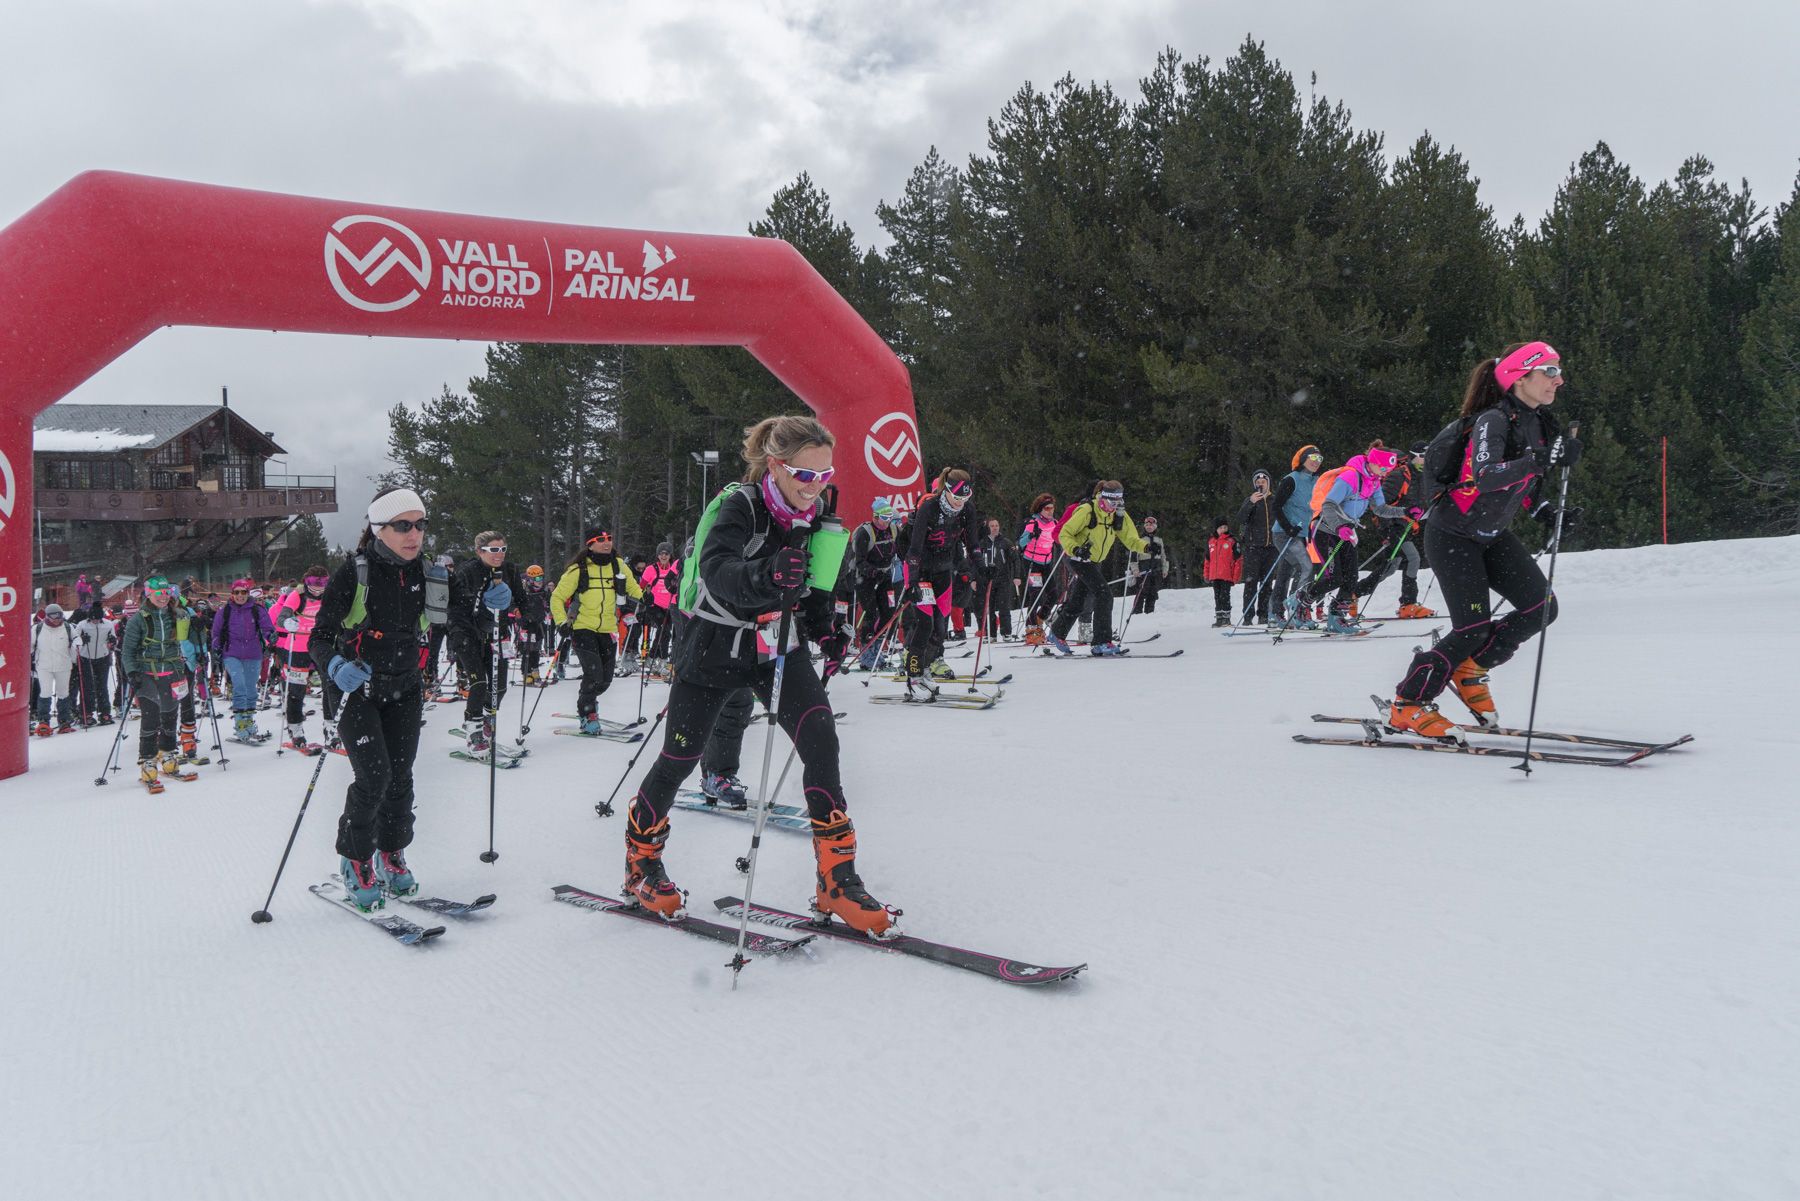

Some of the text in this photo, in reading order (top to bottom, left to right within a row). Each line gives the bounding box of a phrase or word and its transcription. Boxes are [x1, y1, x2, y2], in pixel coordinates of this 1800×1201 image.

[437, 238, 529, 269] VALL
[564, 248, 624, 275] PAL
[442, 264, 541, 296] NORD
[563, 273, 696, 302] ARINSAL
[440, 293, 526, 309] ANDORRA
